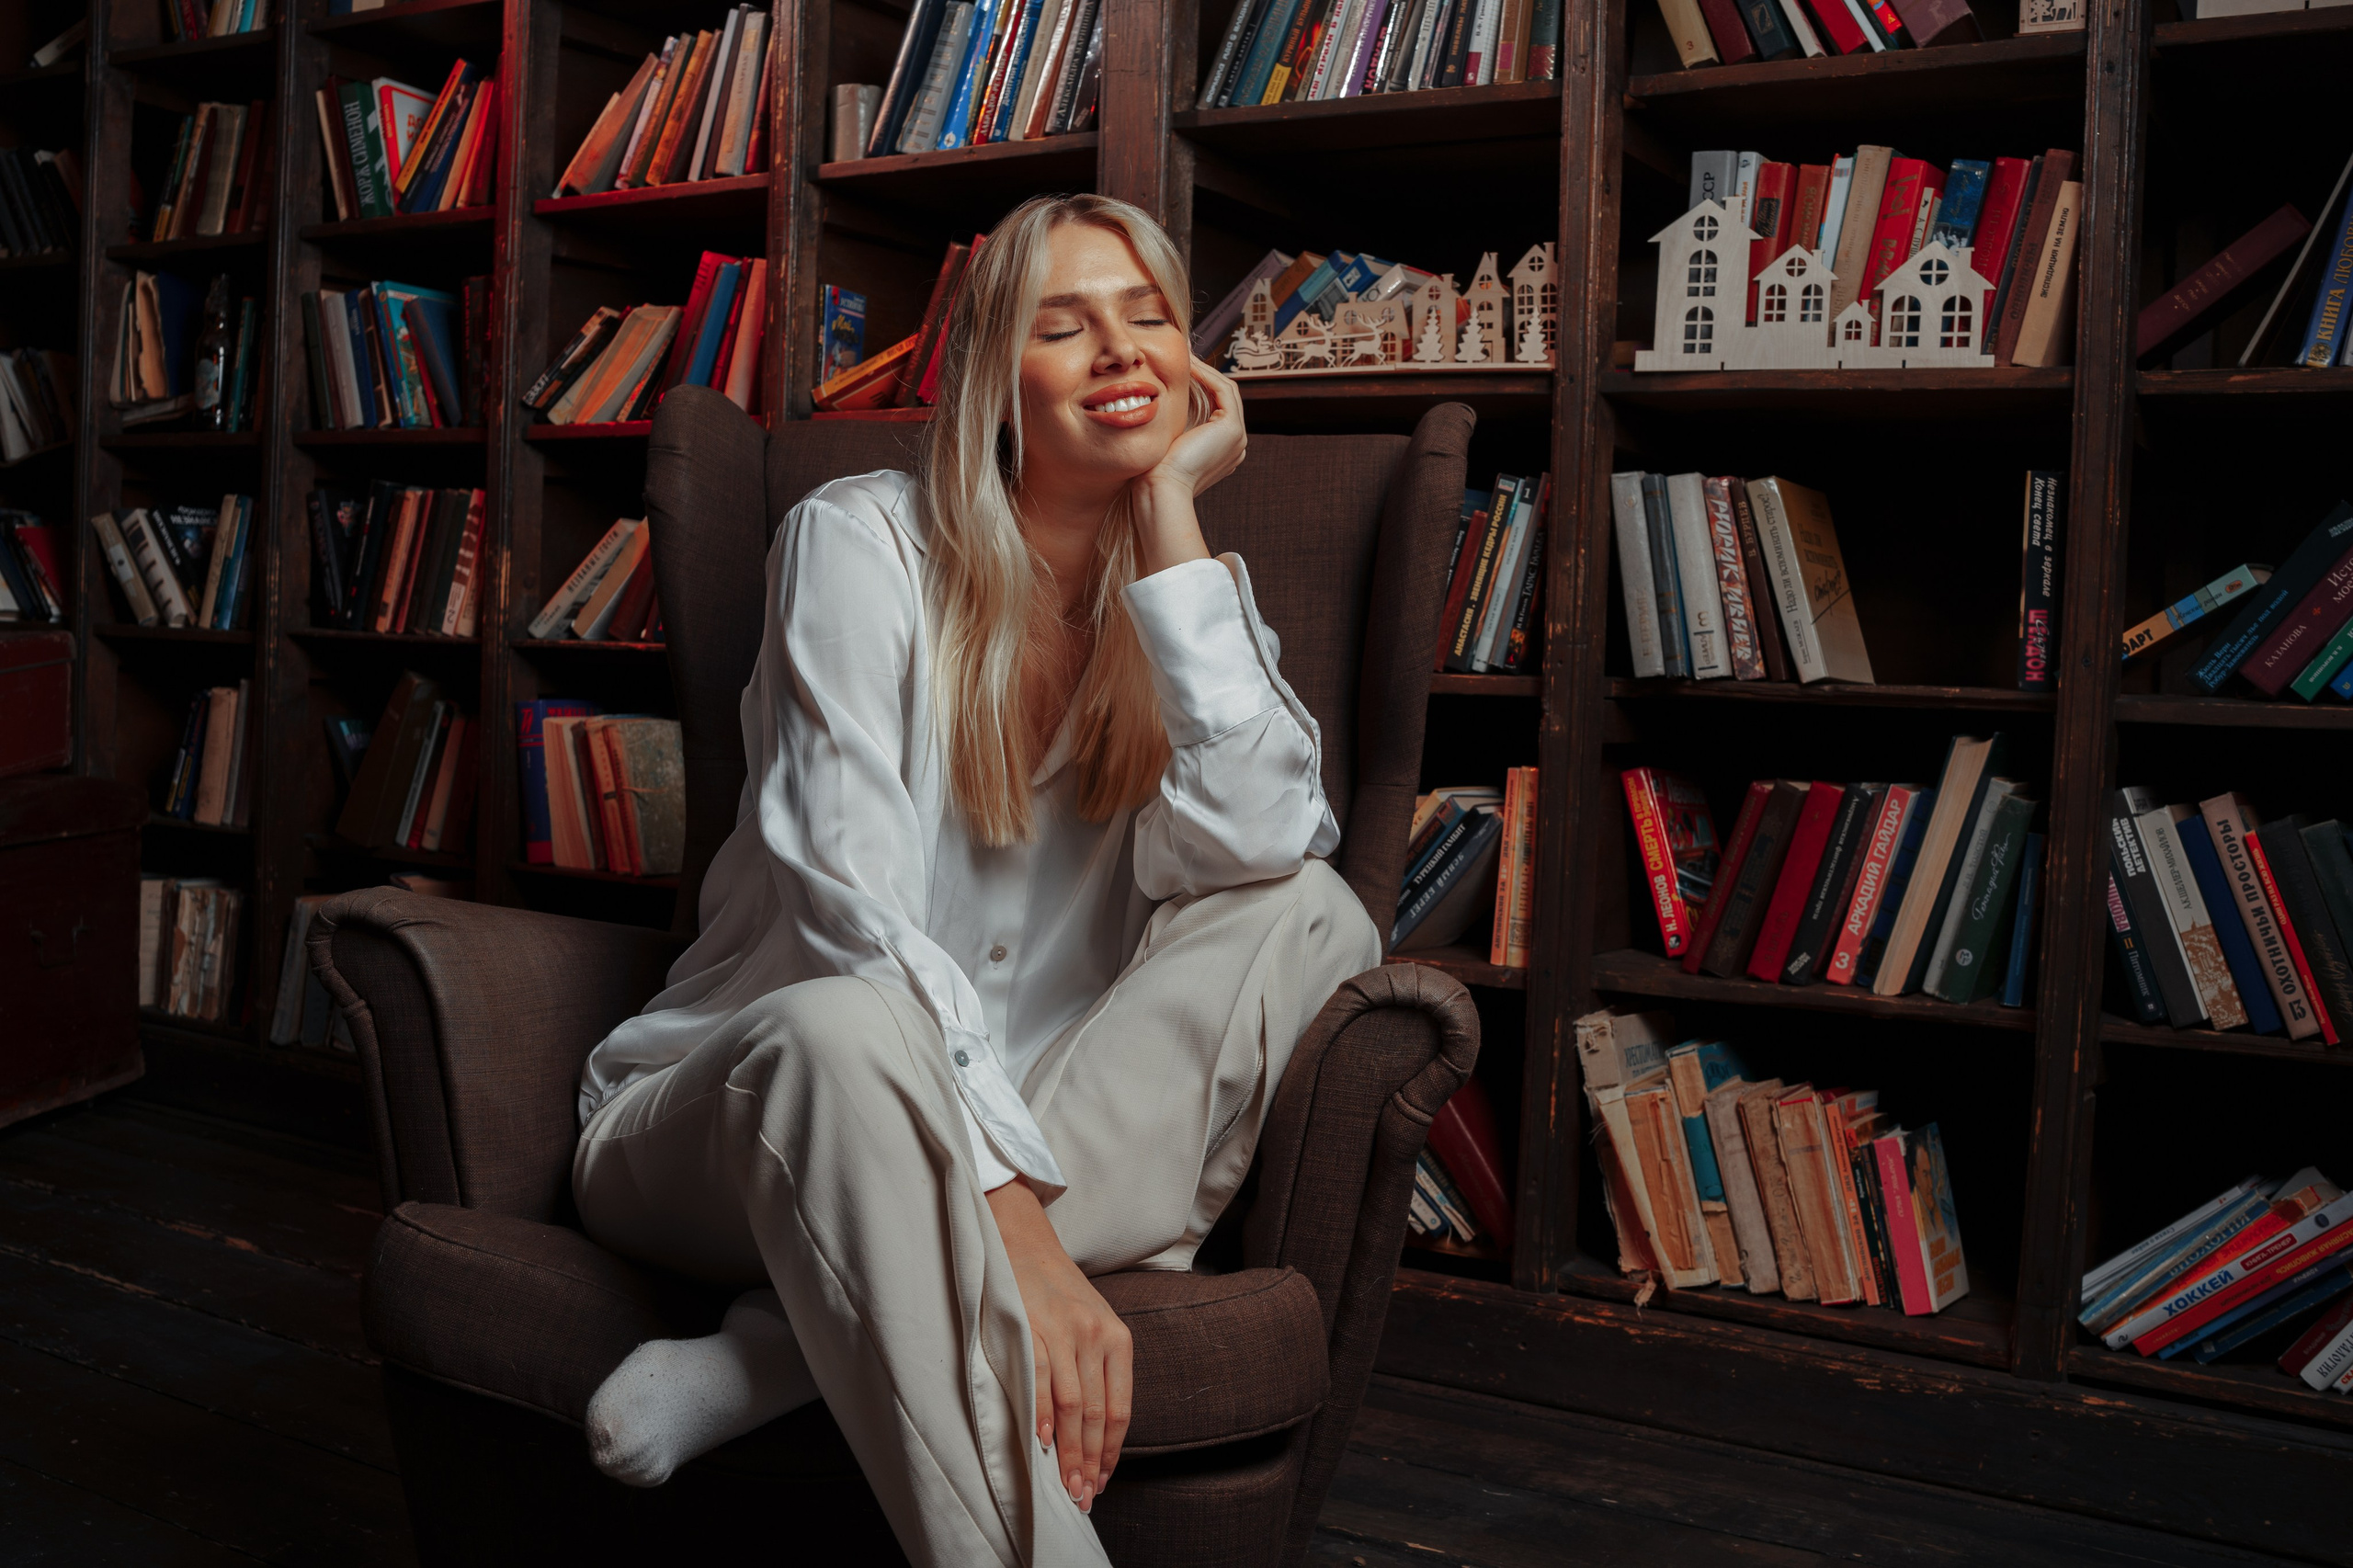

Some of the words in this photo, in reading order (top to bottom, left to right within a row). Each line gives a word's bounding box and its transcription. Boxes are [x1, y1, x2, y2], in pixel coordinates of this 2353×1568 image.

[1280, 27, 1302, 63] КУРИНЫЙ
[341, 100, 370, 165] СИМЕНОН
[354, 165, 376, 205] ЖОРЖ
[2052, 236, 2063, 248] НА
[2055, 207, 2070, 236] ЗЕМЛЮ
[2040, 248, 2060, 298] ЭКСПЕДИЦИЯ
[2315, 286, 2345, 342] КНИГА
[1756, 491, 1777, 527] старое?
[2032, 477, 2045, 508] Конец
[2042, 476, 2057, 540] Незнакомец
[1710, 496, 1742, 584] РЮРИК
[1737, 500, 1754, 545] БУРЦЕВ
[2031, 513, 2041, 546] света
[1469, 557, 1490, 601] ЗВЕНЯЩИЕ
[1482, 527, 1498, 558] КЕДРЫ
[1491, 494, 1507, 528] РОССИИ
[1768, 526, 1789, 577] вспоминать
[1781, 578, 1791, 589] ли
[2040, 555, 2052, 597] зеркале
[1725, 585, 1754, 662] ИВНЕВ
[1781, 589, 1799, 613] Надо
[2025, 608, 2048, 682] ШЕЛДОН
[2201, 651, 2233, 684] Двадцать
[2228, 632, 2249, 654] тысяч
[2245, 621, 2259, 636] лье
[2256, 609, 2270, 623] под
[2267, 587, 2289, 611] водой
[2264, 622, 2308, 668] КАЗАНОВА
[2196, 656, 2217, 678] Жюль
[2213, 641, 2232, 659] Верн
[1637, 817, 1665, 871] СМЕРТЬ
[1836, 795, 1860, 846] Американская
[1411, 846, 1446, 885] ТУРЕЦКИЙ
[1440, 822, 1467, 851] ГАМБИТ
[1847, 859, 1882, 936] АРКАДИЙ
[1870, 797, 1904, 859] ГАЙДАР
[2120, 816, 2146, 875] ДЕТЕКТИВ
[2216, 817, 2259, 903] ПРОСТОРЫ
[2251, 846, 2266, 871] ЖИЗНЬ
[1817, 845, 1844, 900] фантастическая
[1652, 873, 1676, 920] ЛЕОНОВ
[1811, 899, 1823, 919] проза
[2270, 894, 2280, 907] РАЗ
[2275, 905, 2288, 925] ОДИН
[1665, 918, 1678, 932] Н.
[2127, 949, 2150, 997] Питомник
[2251, 904, 2297, 996] ОХОТНИЧЬИ
[2244, 1235, 2294, 1267] КНИГА-ТРЕНЕР
[2274, 1246, 2318, 1277] ЖИВОПИСЬ
[2162, 1267, 2235, 1317] ХОККЕЙ
